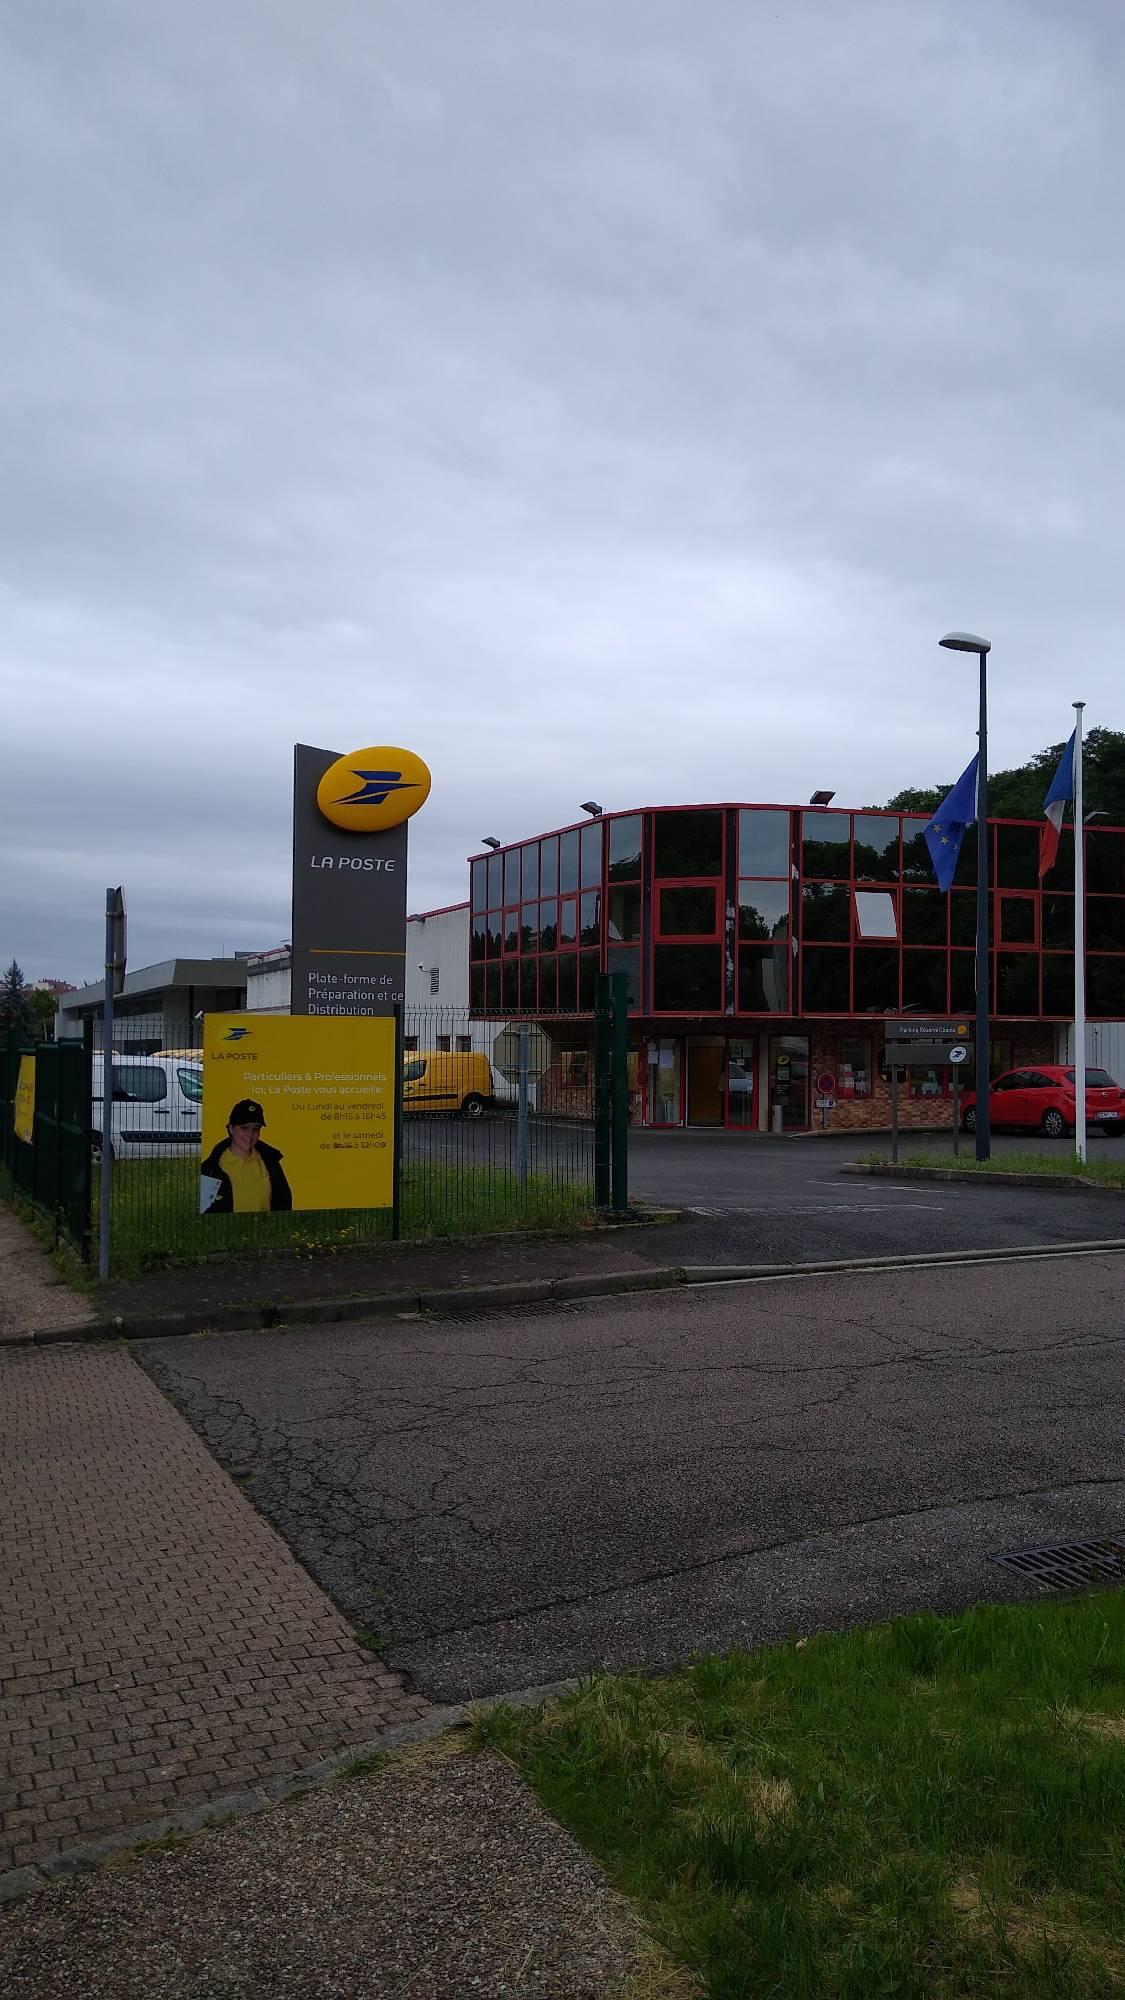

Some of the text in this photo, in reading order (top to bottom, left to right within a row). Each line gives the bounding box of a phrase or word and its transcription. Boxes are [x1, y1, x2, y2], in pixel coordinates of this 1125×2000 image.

[311, 856, 395, 872] LA POSTE
[308, 972, 393, 985] Plate-forme de
[308, 987, 375, 1003] Préparation
[377, 990, 388, 1001] et
[308, 1003, 374, 1015] Distribution
[211, 1052, 258, 1060] LA POSTE
[243, 1072, 387, 1081] Particuliers & Professionnels
[268, 1085, 281, 1094] La
[283, 1085, 311, 1094] Poste
[339, 1085, 382, 1094] accueille
[346, 1102, 384, 1110] vendredi
[320, 1112, 332, 1121] de
[343, 1131, 352, 1139] le
[352, 1131, 384, 1139] samedi
[319, 1142, 331, 1150] de
